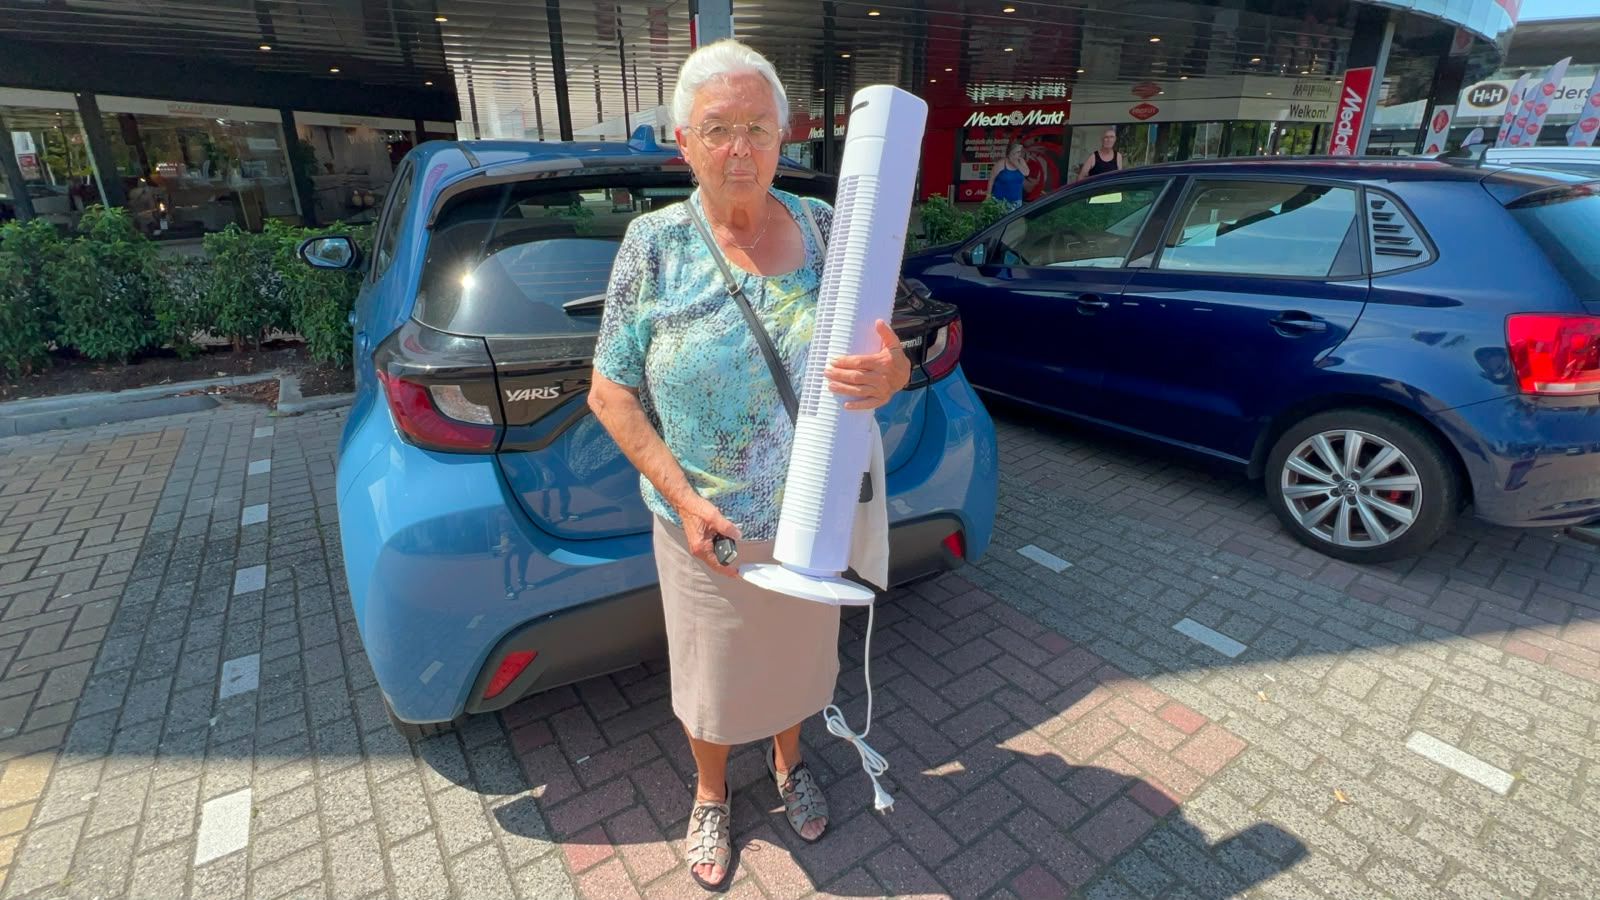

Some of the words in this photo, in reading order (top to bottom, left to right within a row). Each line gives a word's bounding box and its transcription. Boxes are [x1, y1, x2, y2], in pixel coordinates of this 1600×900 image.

[1472, 88, 1504, 103] H&H
[1289, 103, 1330, 119] Welkom!
[1335, 86, 1363, 145] Media
